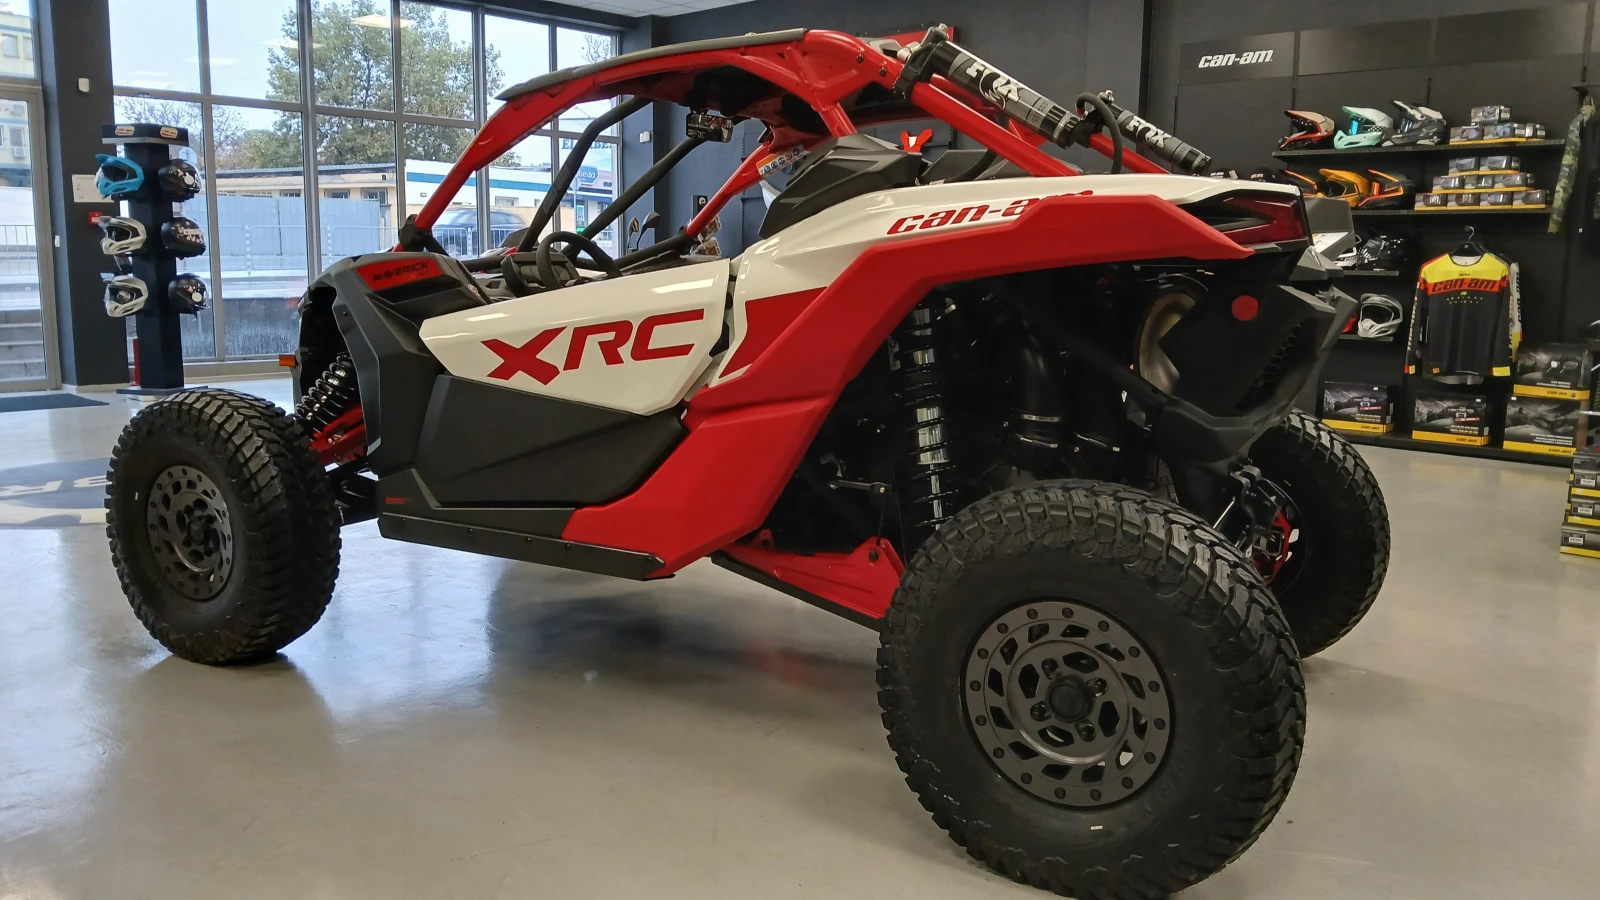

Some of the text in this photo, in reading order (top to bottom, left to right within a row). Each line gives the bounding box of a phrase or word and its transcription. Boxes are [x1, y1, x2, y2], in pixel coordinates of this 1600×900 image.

[1198, 49, 1274, 68] can-am
[965, 60, 1020, 109] FOX
[1126, 115, 1172, 149] FOX
[886, 190, 1093, 235] can-a
[373, 260, 429, 282] MAVERICK
[1431, 279, 1496, 293] can-am
[480, 308, 704, 386] XRC
